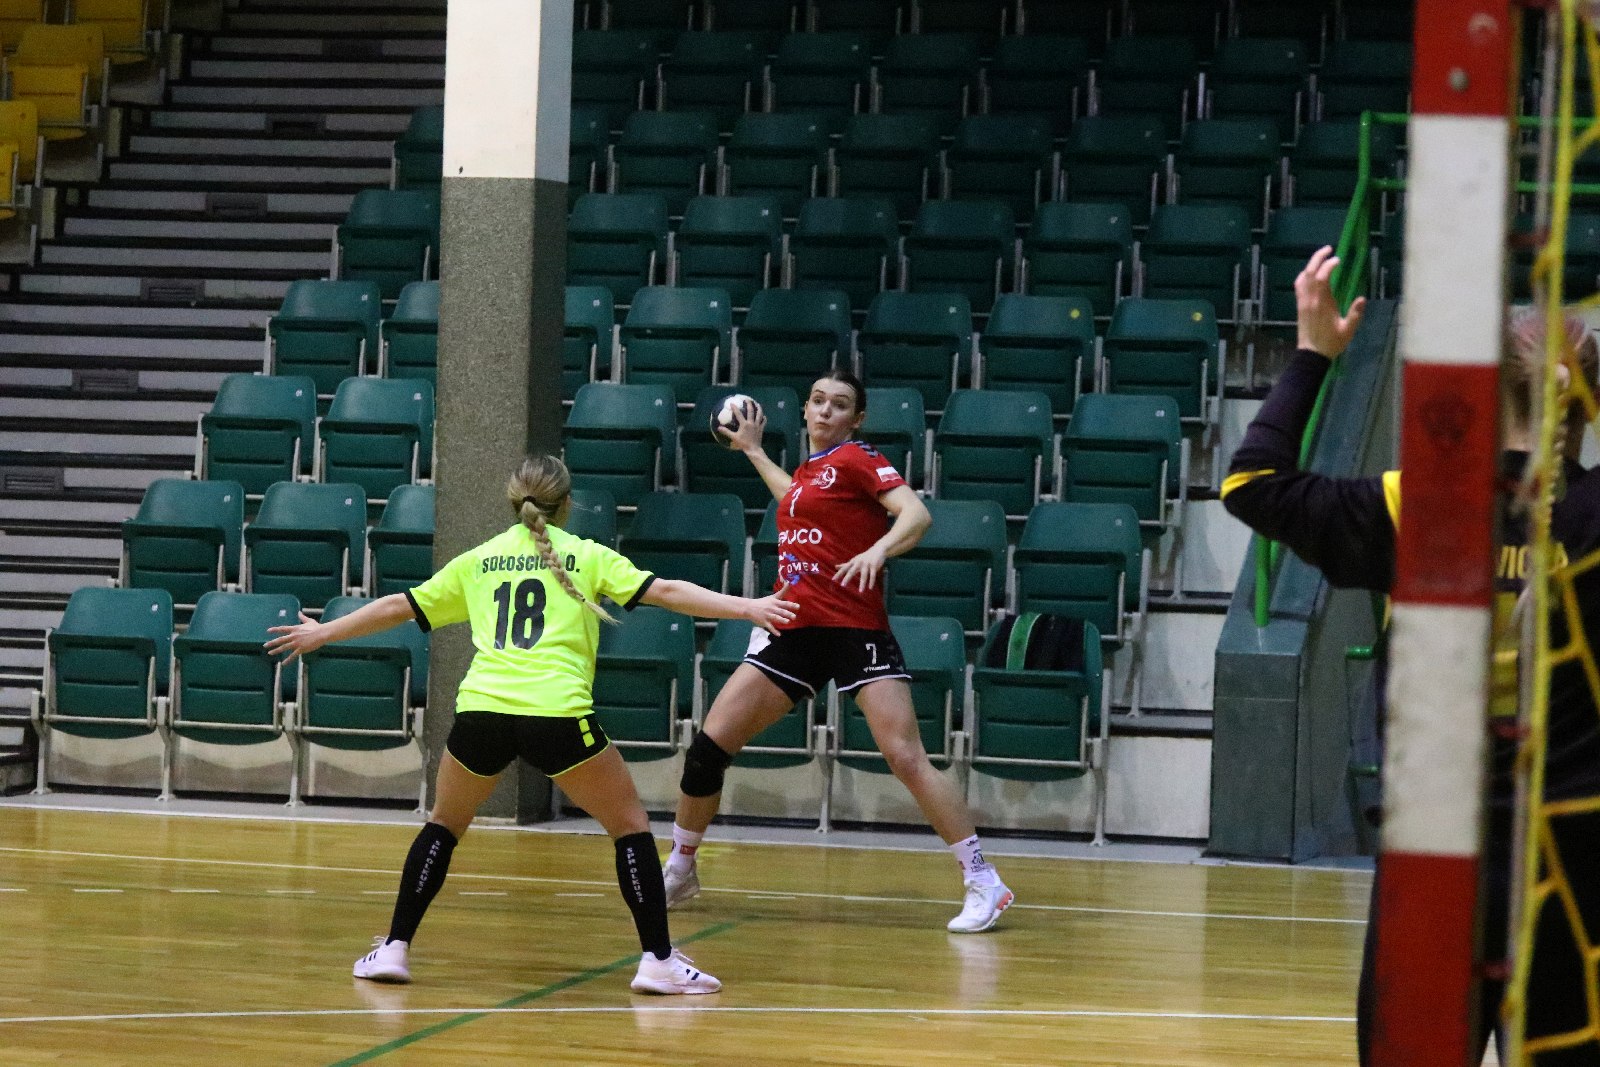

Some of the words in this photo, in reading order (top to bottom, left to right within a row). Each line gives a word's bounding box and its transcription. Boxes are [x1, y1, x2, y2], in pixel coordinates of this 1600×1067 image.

[481, 553, 552, 574] SOŁOŚCIU
[565, 553, 581, 573] O.
[493, 578, 547, 650] 18
[865, 643, 877, 665] 7
[630, 867, 644, 903] OLKUSZ
